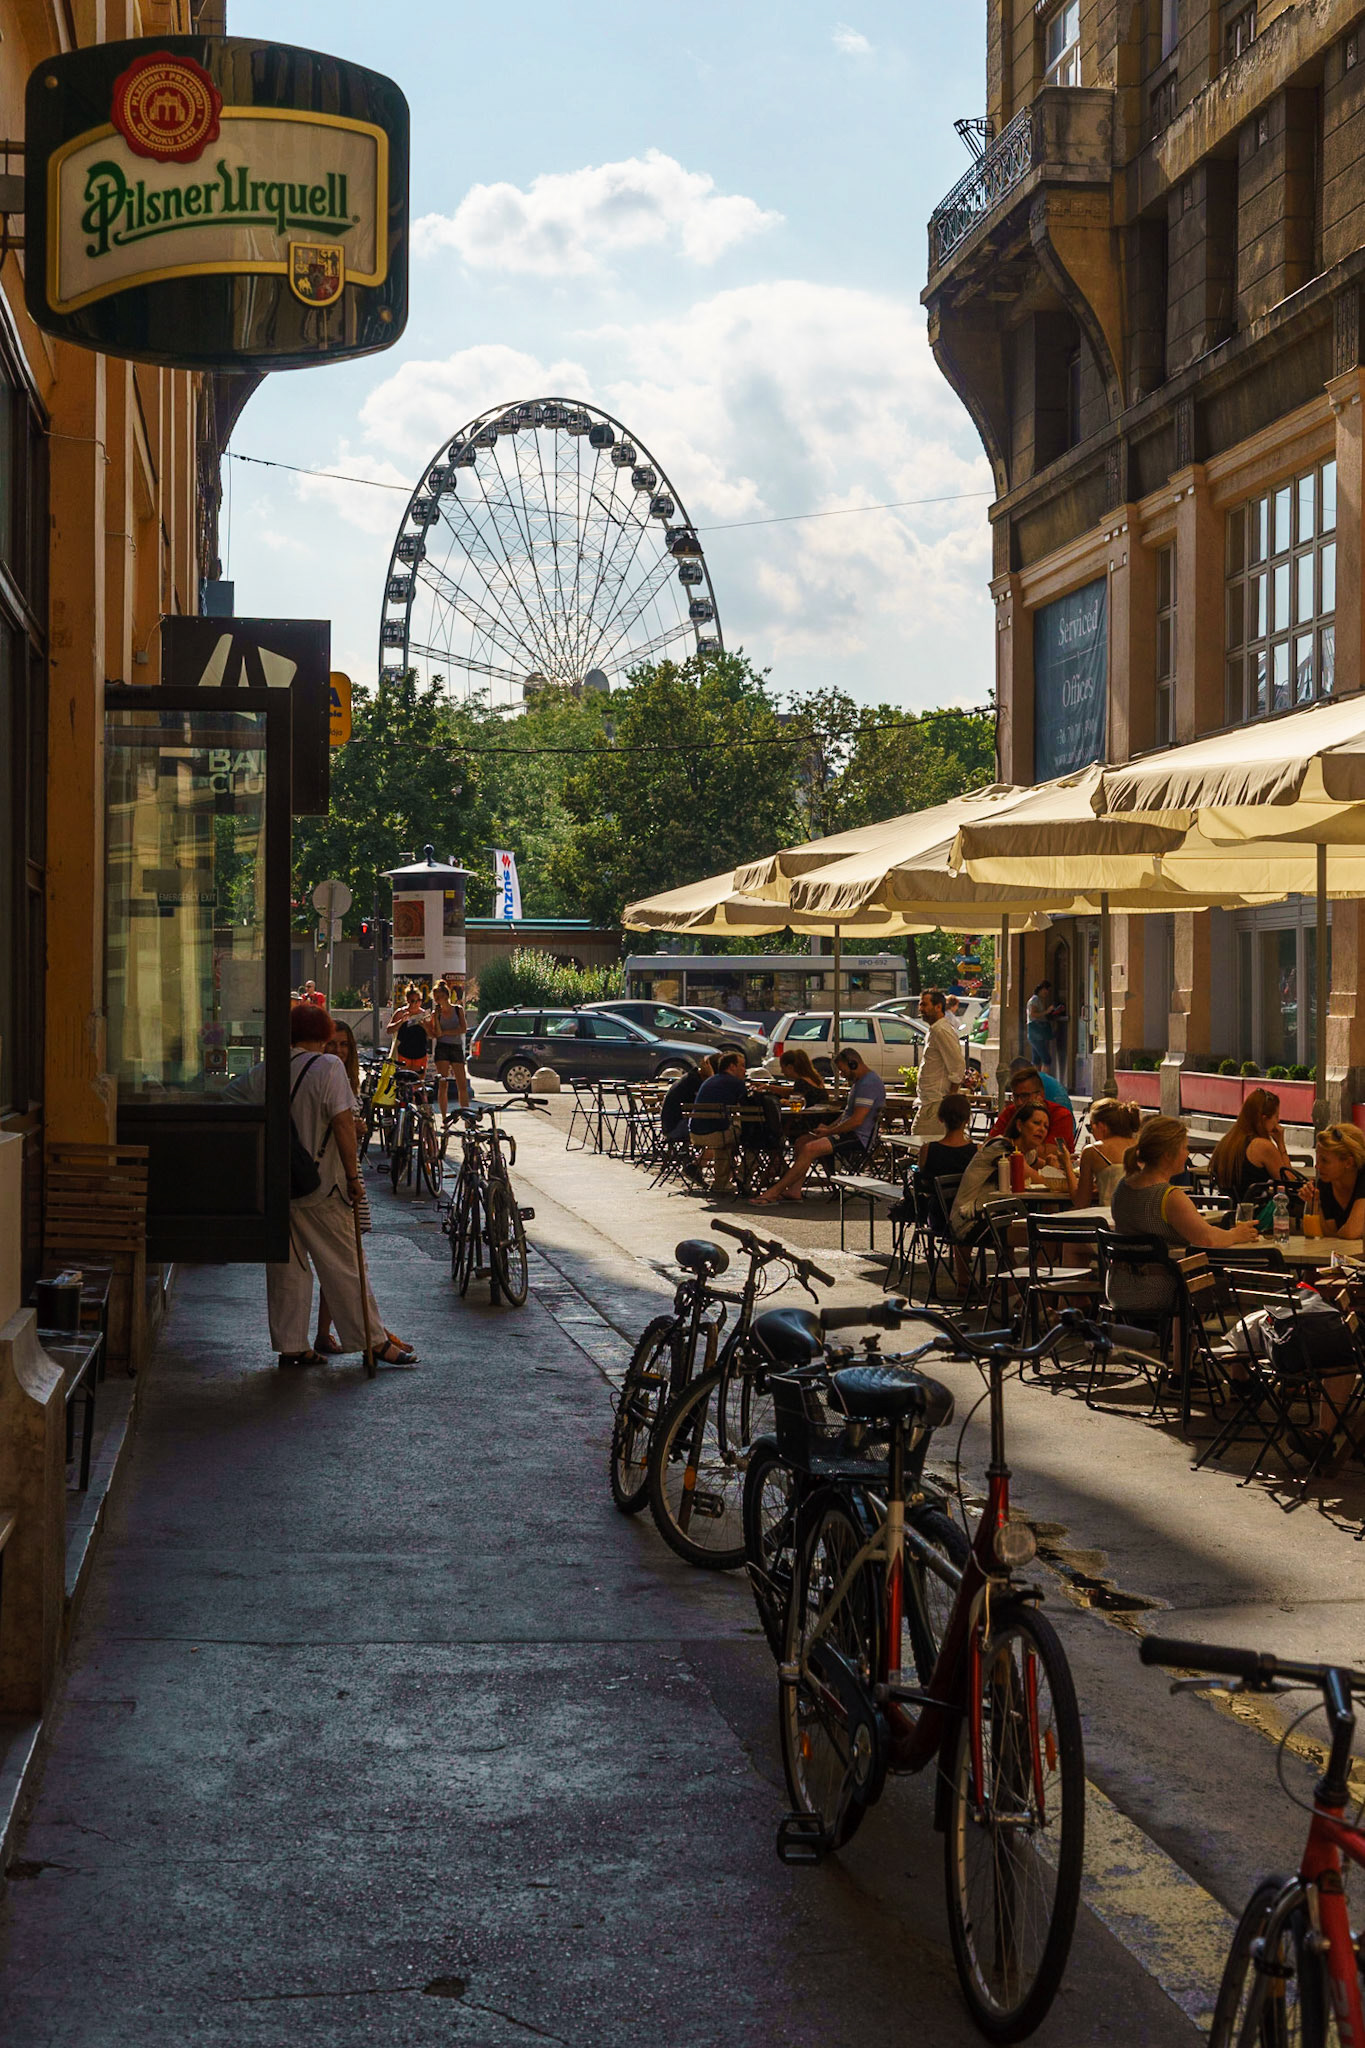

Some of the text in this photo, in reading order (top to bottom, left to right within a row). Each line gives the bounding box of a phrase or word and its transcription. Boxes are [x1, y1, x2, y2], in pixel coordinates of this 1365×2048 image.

[149, 134, 175, 145] ROKU
[81, 159, 348, 259] Pilsner Urquell
[1058, 599, 1098, 646] Serviced
[1062, 674, 1094, 708] Offices
[158, 892, 217, 901] EMERGENCY EXIT
